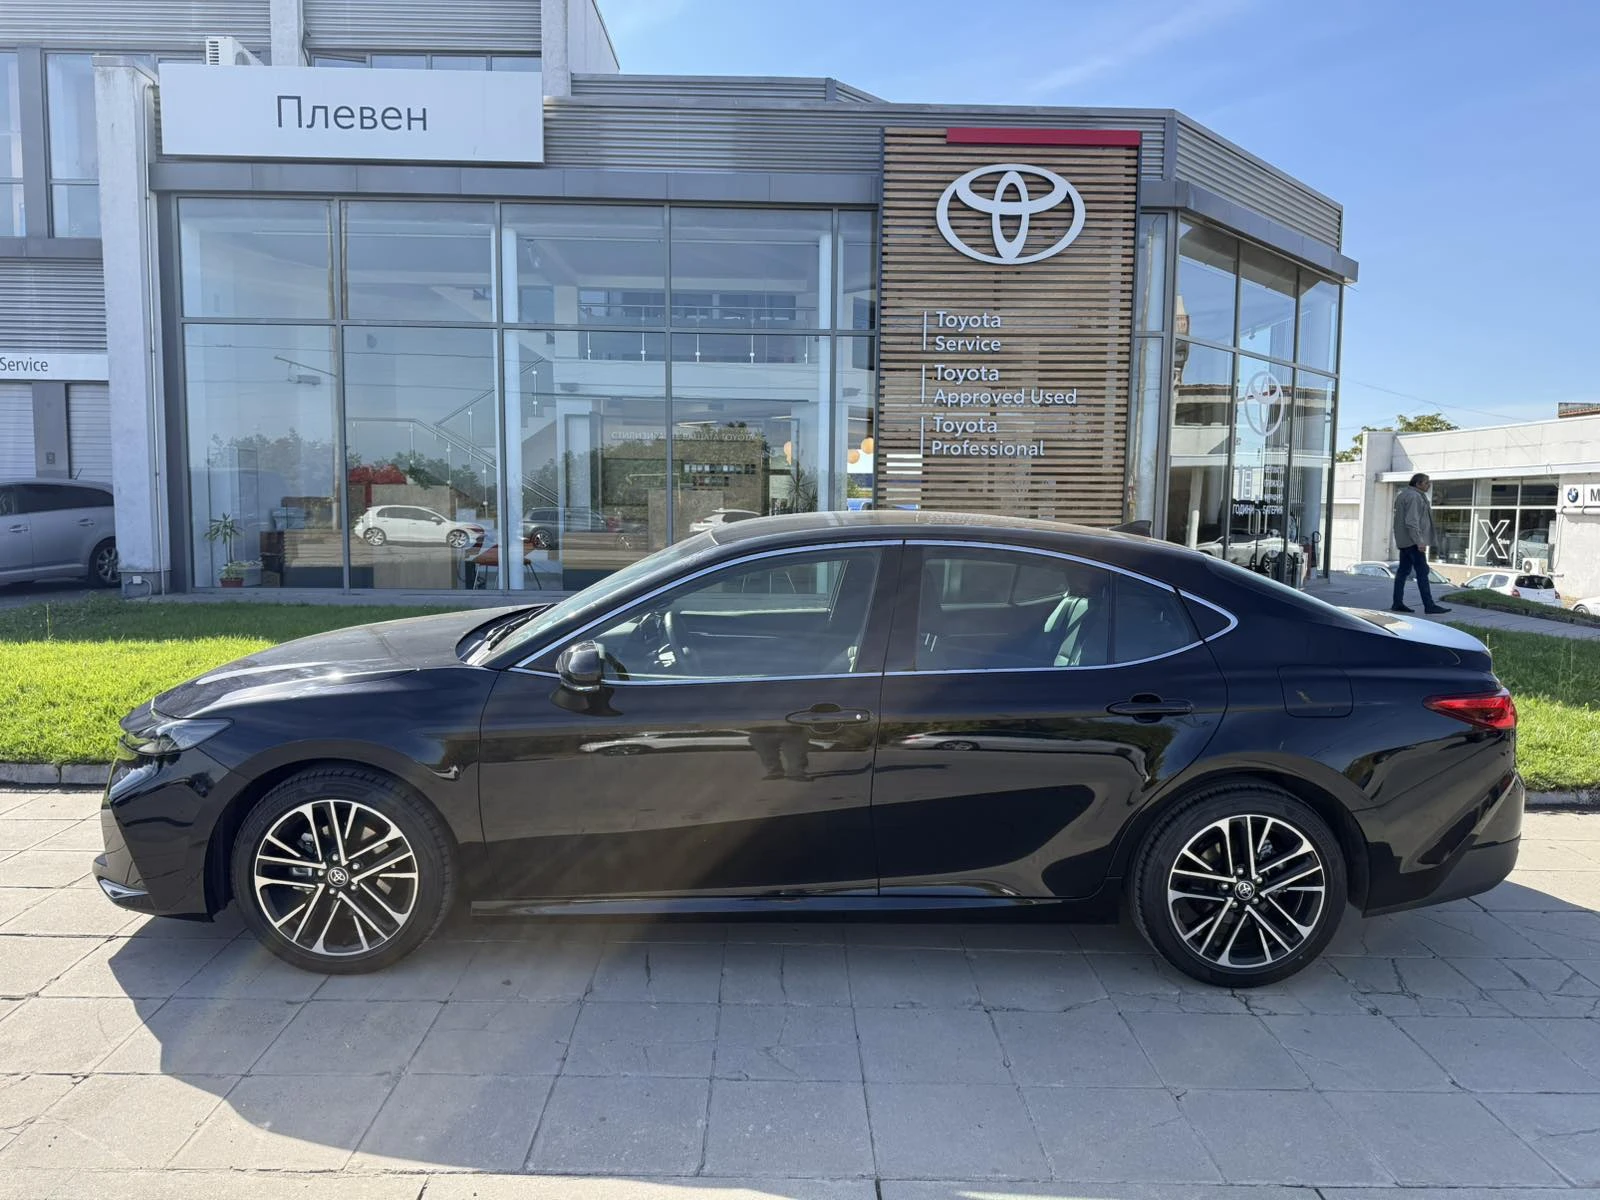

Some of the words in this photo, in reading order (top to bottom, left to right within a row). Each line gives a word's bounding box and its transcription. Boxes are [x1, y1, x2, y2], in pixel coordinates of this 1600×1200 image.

[276, 95, 428, 132] Плевен
[935, 311, 1002, 332] Toyota
[934, 335, 1001, 352] Service
[0, 356, 49, 372] Service
[933, 364, 1000, 385] Toyota
[933, 387, 1025, 407] Approved
[1030, 387, 1078, 404] Used
[932, 416, 998, 437] Toyota
[931, 440, 1045, 457] Professional
